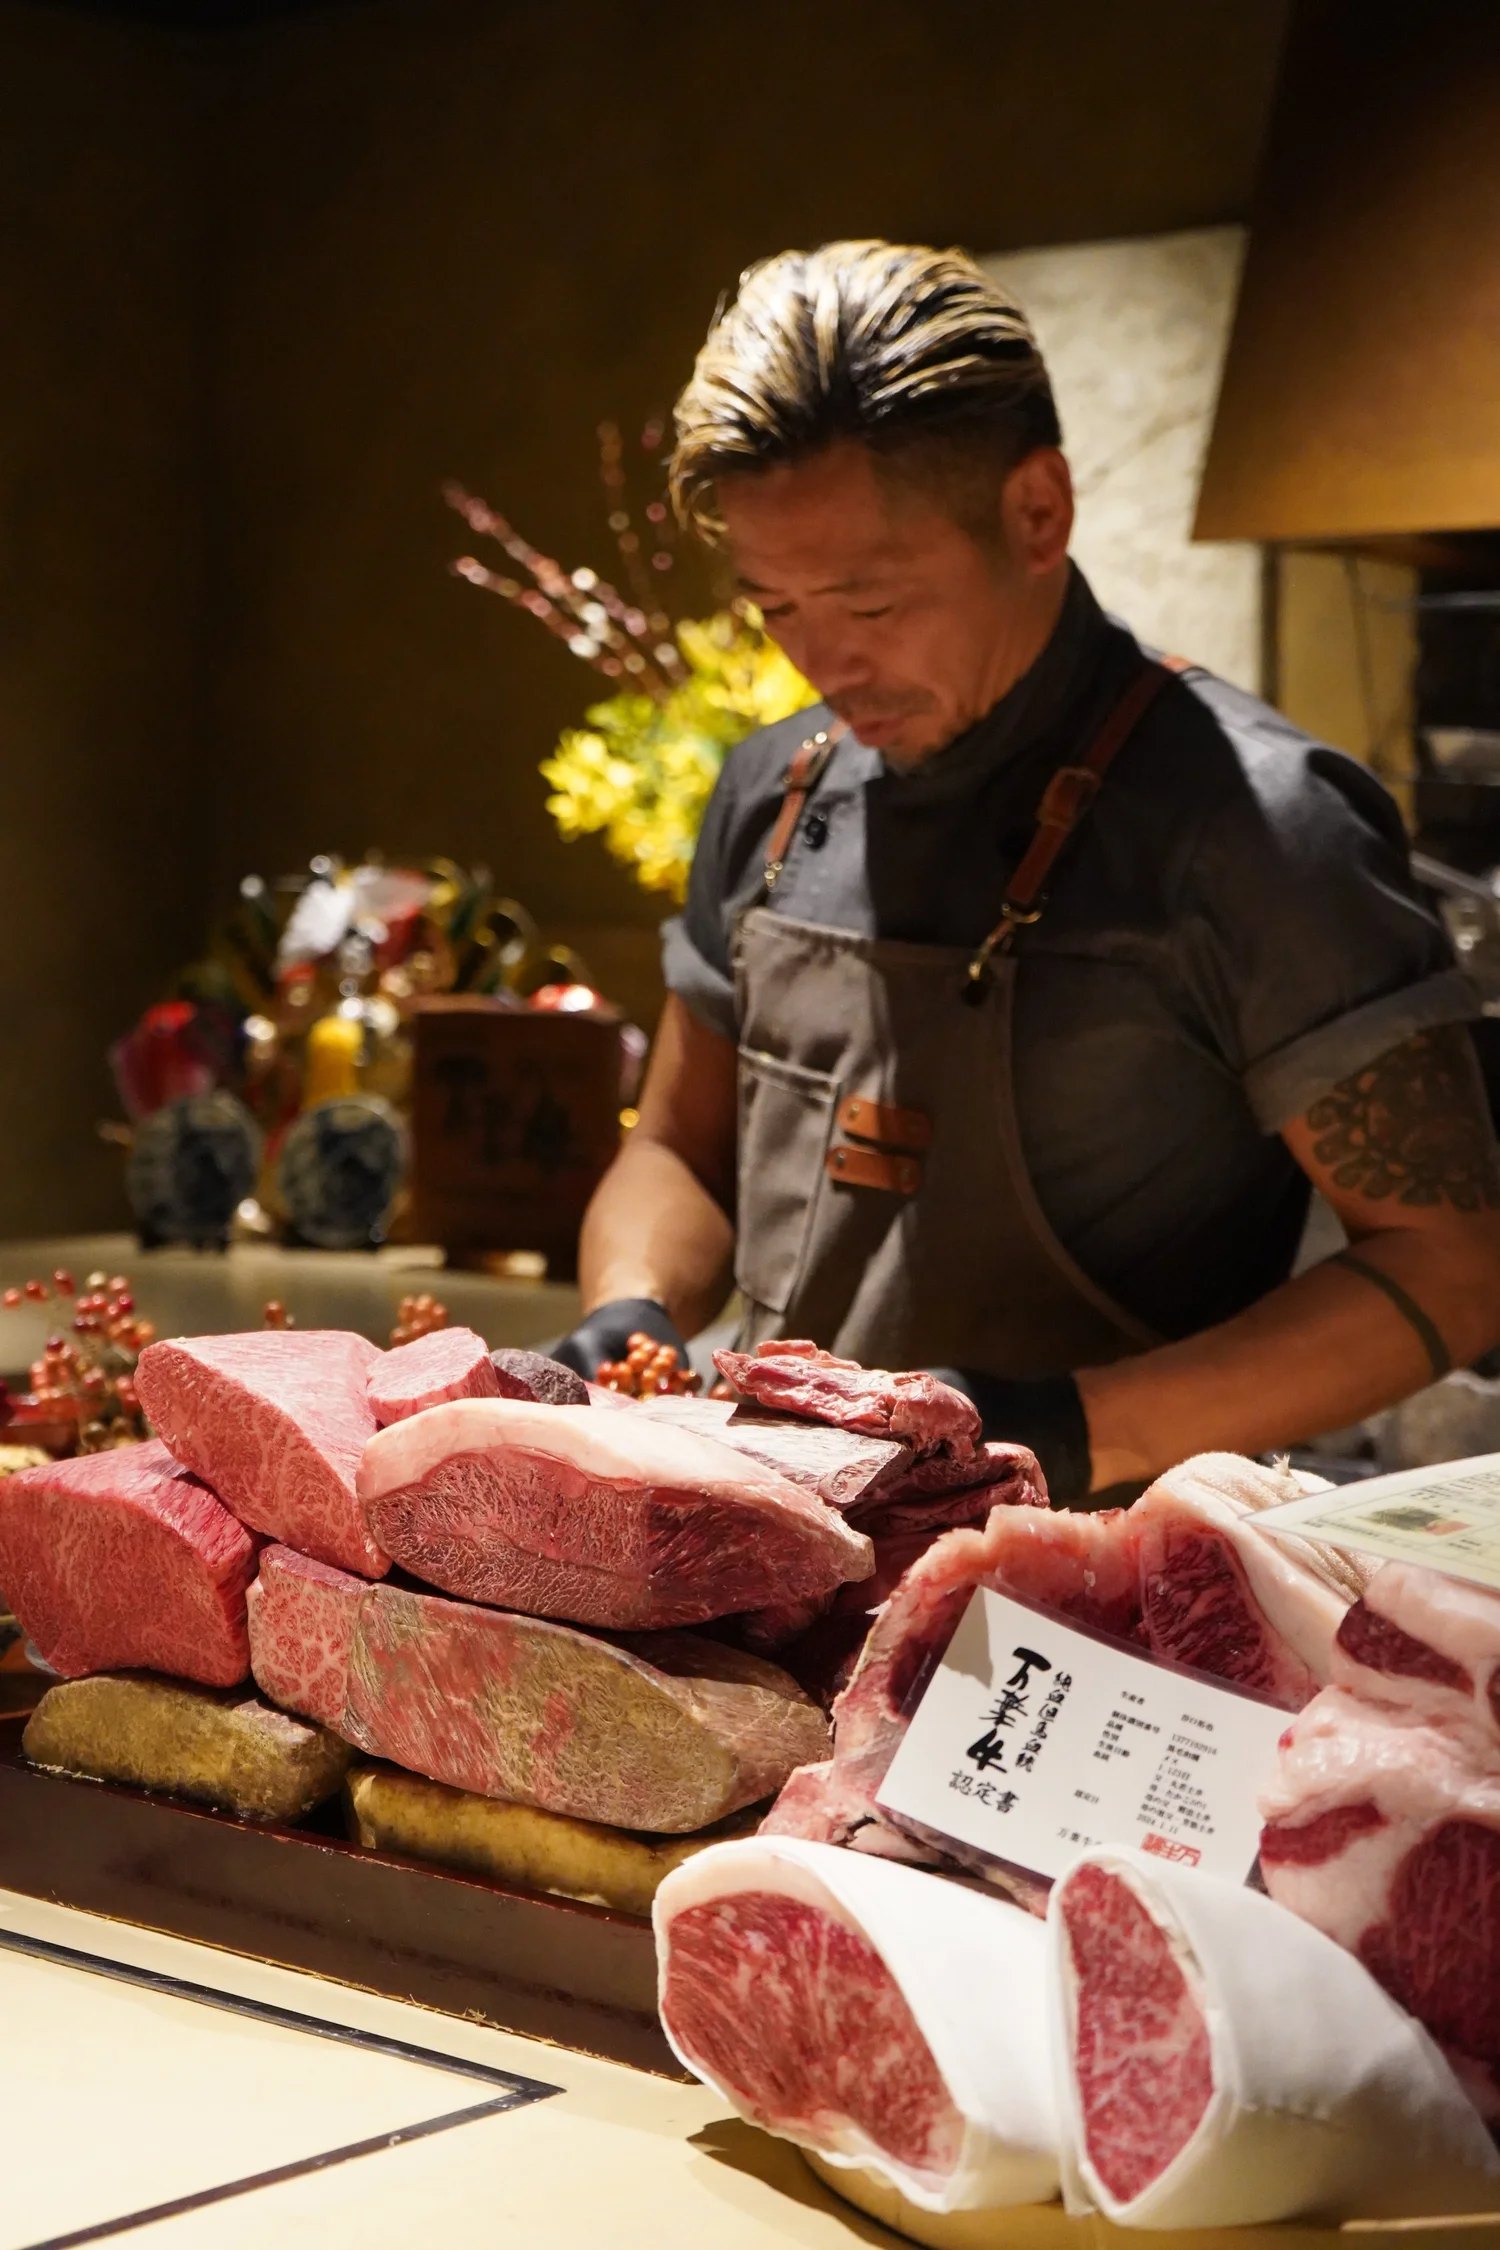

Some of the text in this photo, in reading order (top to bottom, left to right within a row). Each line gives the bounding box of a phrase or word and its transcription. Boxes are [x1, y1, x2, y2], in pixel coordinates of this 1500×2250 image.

[966, 1646, 1052, 1775] 万葉牛
[1014, 1670, 1073, 1773] 純血但馬血統
[948, 1769, 1020, 1814] 認定書
